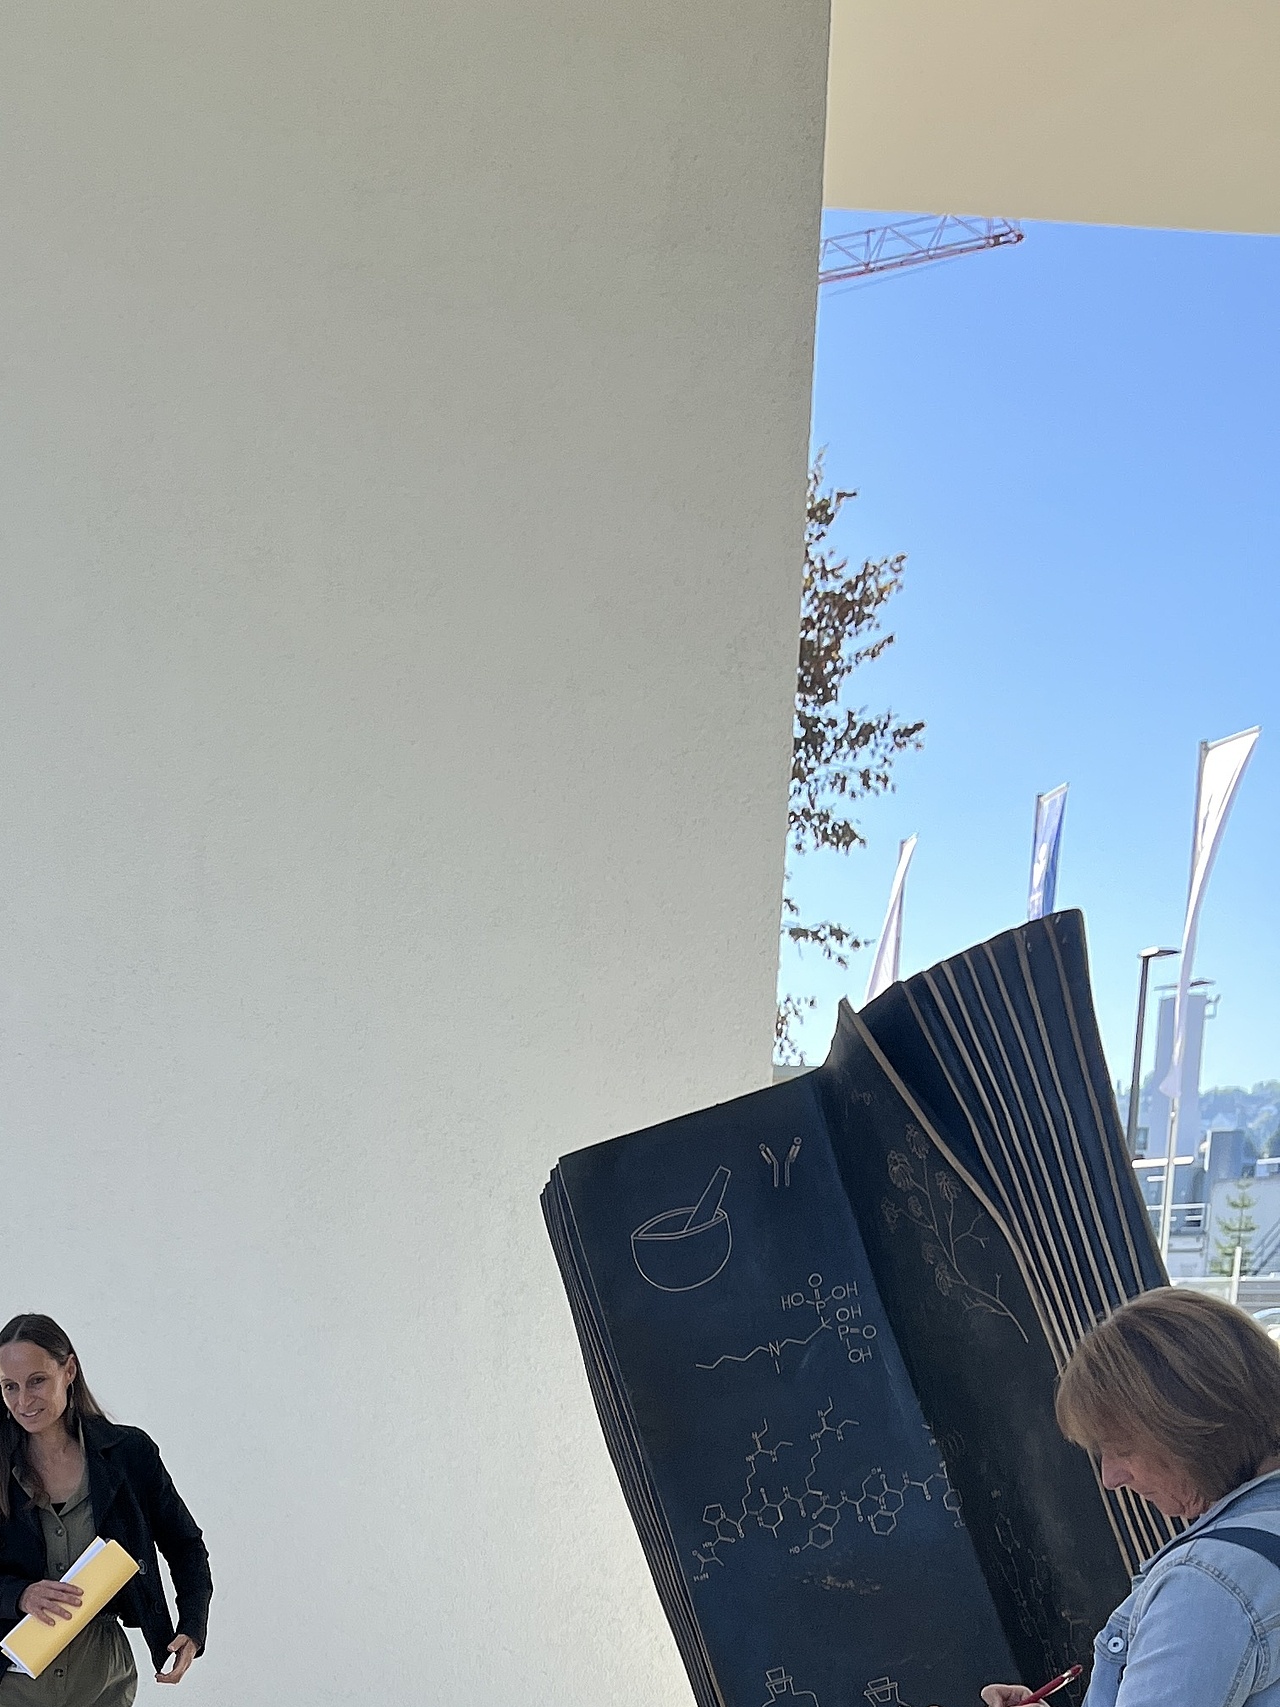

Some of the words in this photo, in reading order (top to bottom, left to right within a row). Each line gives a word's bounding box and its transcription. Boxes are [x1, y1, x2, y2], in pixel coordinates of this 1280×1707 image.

[831, 1280, 859, 1300] OH
[781, 1291, 805, 1312] HO
[836, 1303, 862, 1322] OH
[848, 1345, 873, 1363] OH
